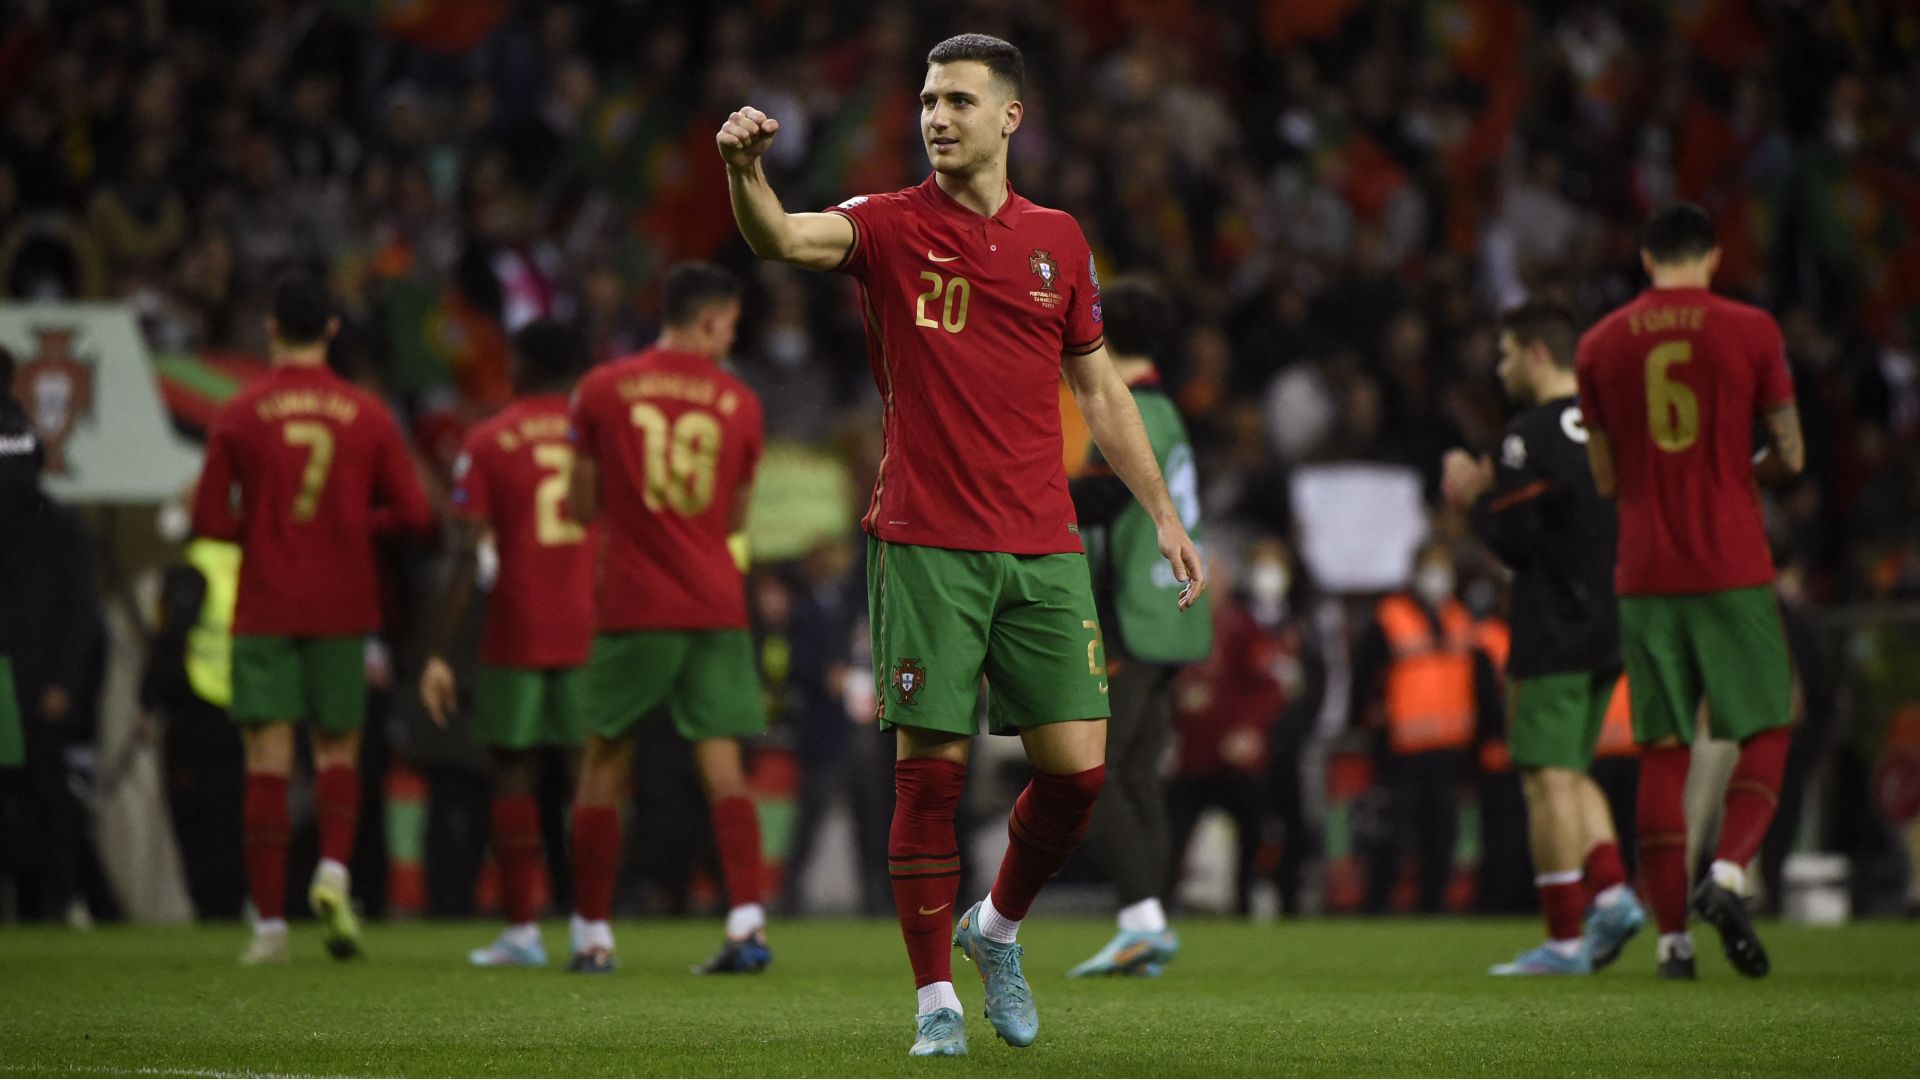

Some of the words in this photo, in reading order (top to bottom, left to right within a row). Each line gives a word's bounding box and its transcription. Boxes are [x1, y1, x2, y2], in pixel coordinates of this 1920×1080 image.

[915, 270, 971, 333] 20
[1647, 340, 1698, 452] 6
[282, 420, 336, 521] 7
[531, 442, 588, 546] 2
